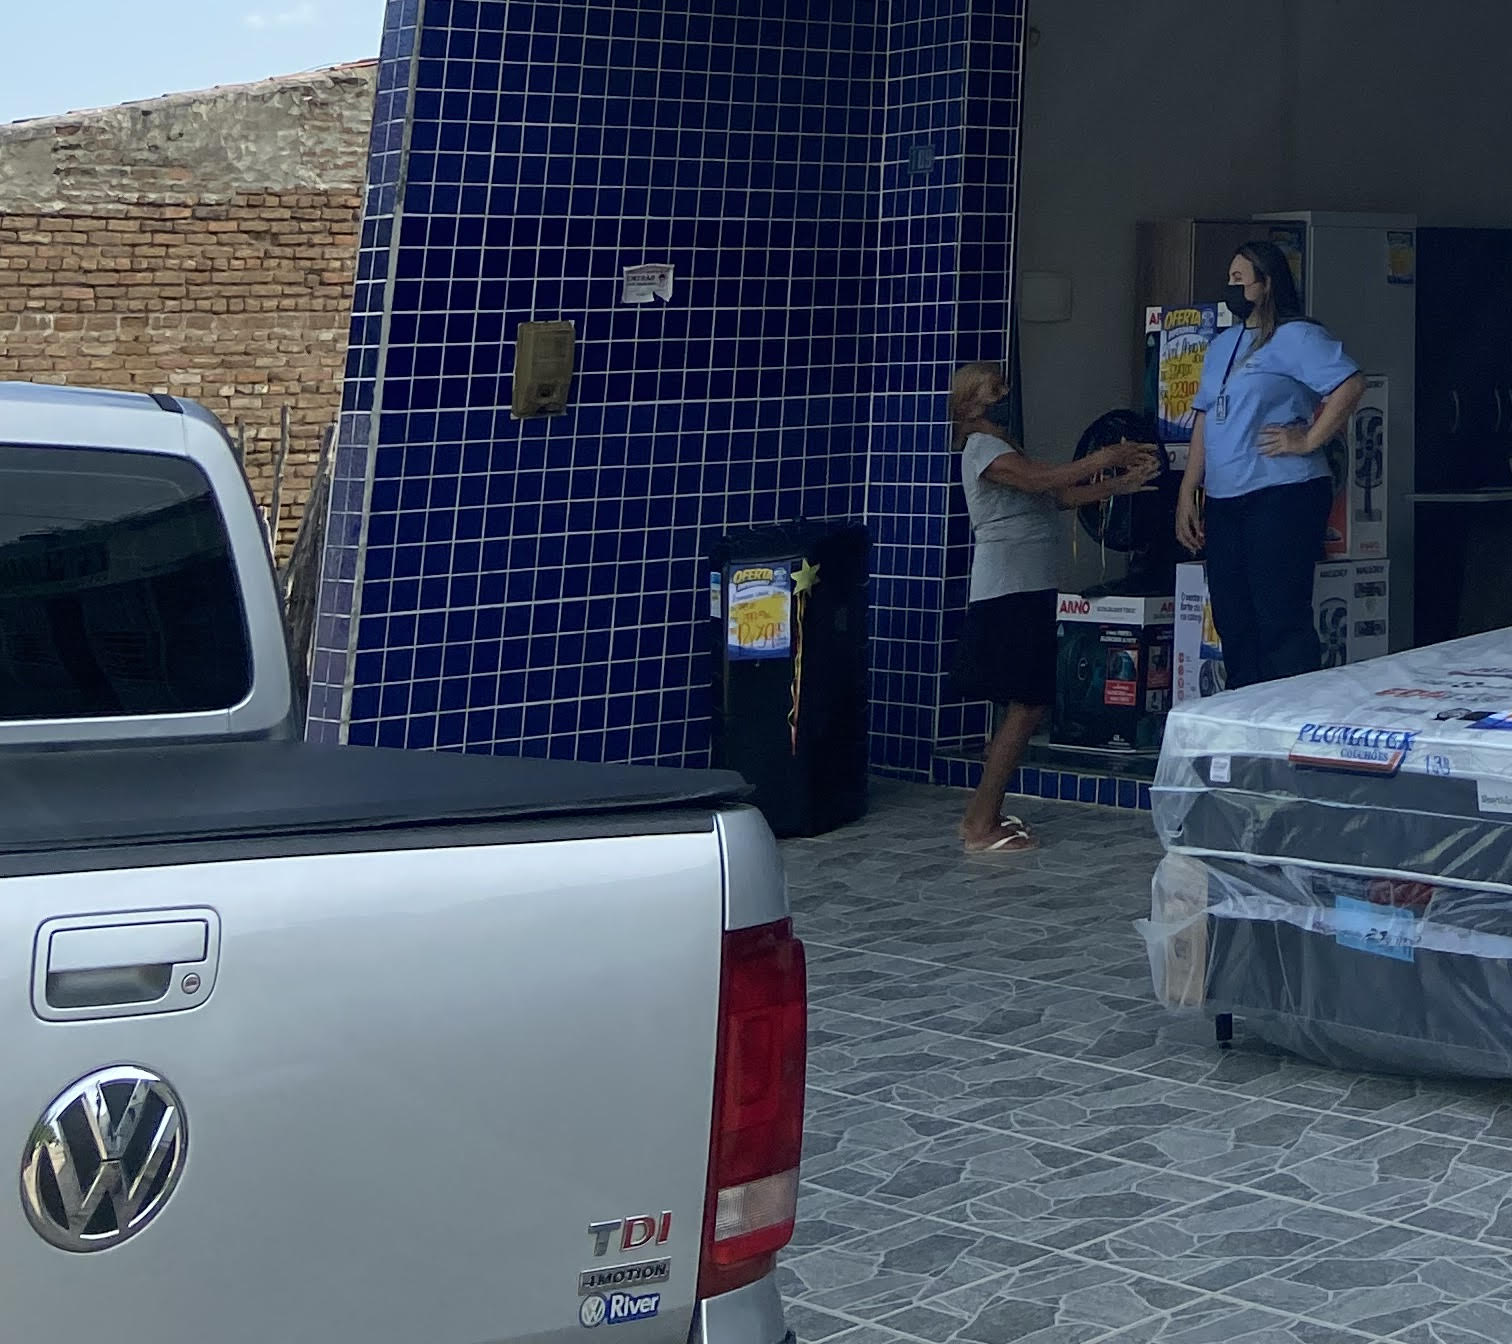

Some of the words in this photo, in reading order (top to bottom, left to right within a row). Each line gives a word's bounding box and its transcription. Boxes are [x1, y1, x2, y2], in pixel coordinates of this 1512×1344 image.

[1164, 309, 1200, 331] OFERTA
[733, 568, 773, 584] OFERTA
[1060, 599, 1091, 615] ARNO
[1297, 723, 1422, 751] PLUMATEX
[588, 1210, 672, 1257] TDI
[582, 1262, 667, 1287] 4MOTION
[609, 1293, 660, 1320] River
